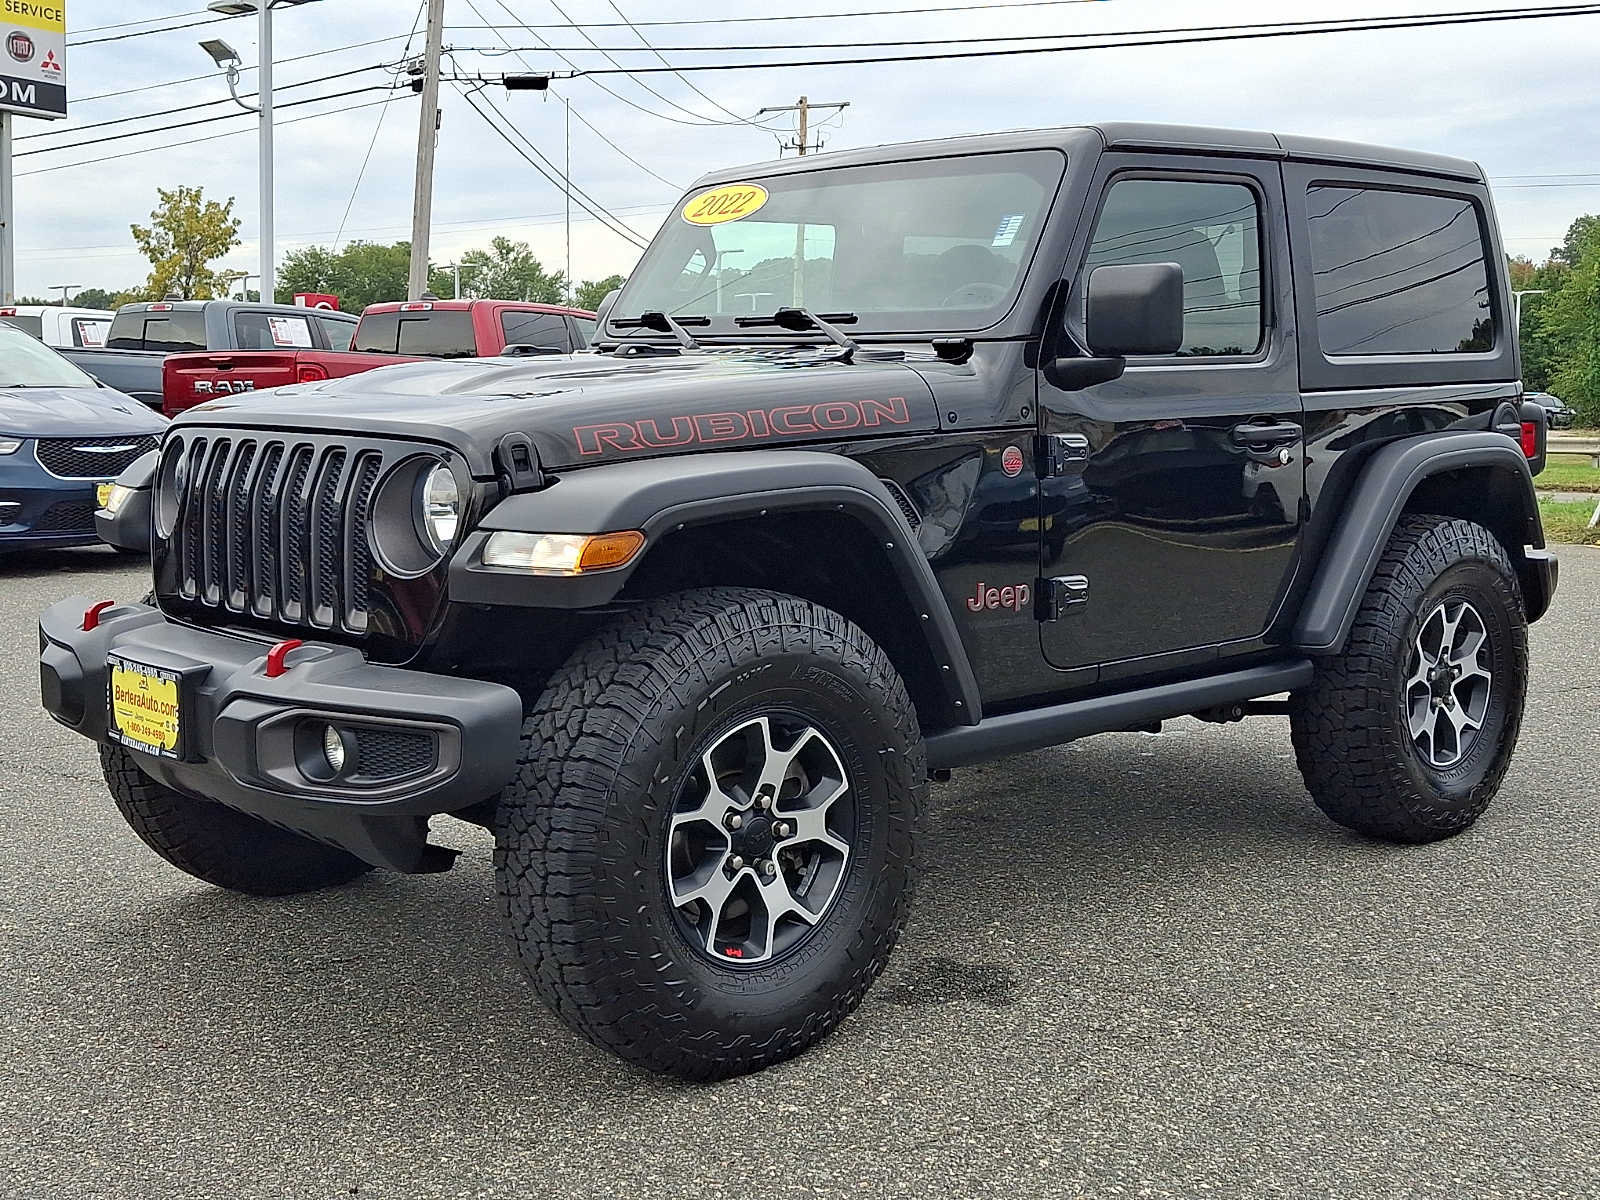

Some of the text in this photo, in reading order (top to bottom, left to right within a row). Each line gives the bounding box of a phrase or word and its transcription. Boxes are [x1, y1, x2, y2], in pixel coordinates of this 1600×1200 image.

[5, 0, 61, 21] SERVICE
[692, 191, 757, 217] 2022
[194, 380, 255, 393] RAM
[573, 397, 911, 455] RUBICON
[967, 582, 1031, 612] Jeep
